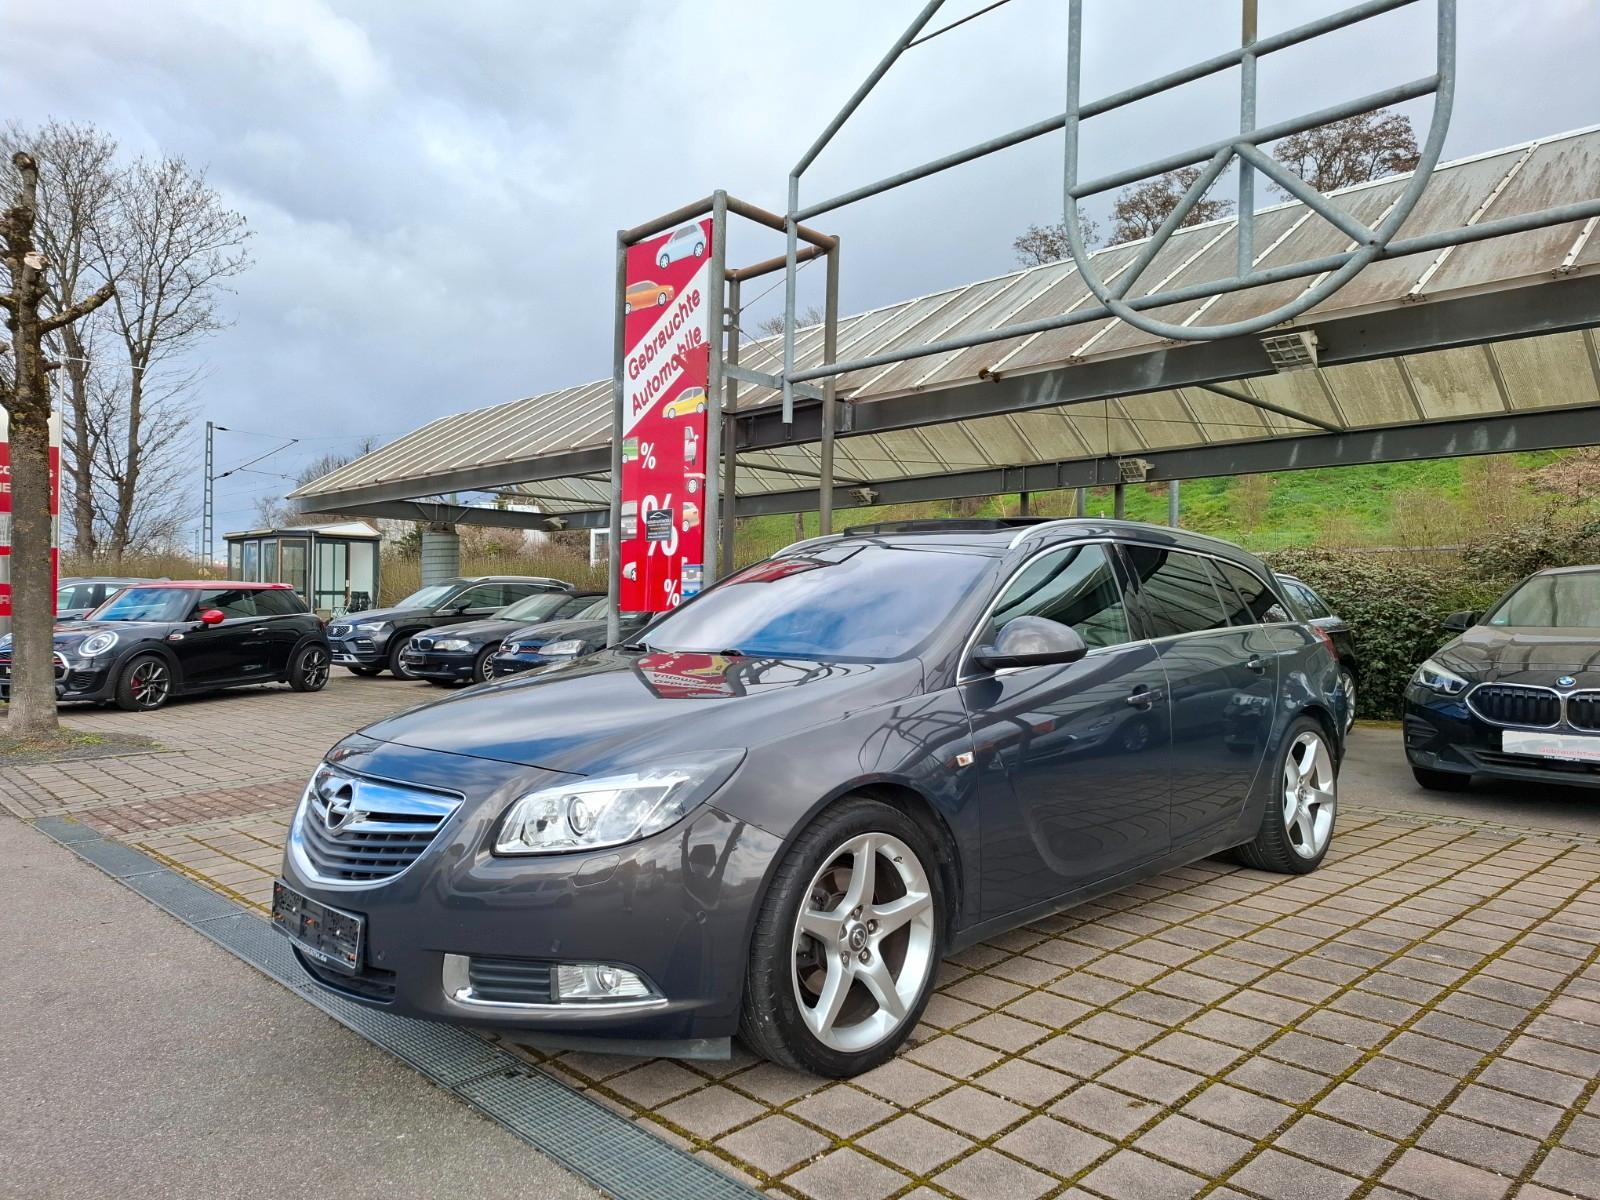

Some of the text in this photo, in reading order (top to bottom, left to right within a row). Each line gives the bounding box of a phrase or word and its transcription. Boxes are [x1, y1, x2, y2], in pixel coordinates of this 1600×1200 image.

[629, 288, 700, 380] Gebrauchte
[640, 442, 656, 470] %
[664, 578, 680, 606] %
